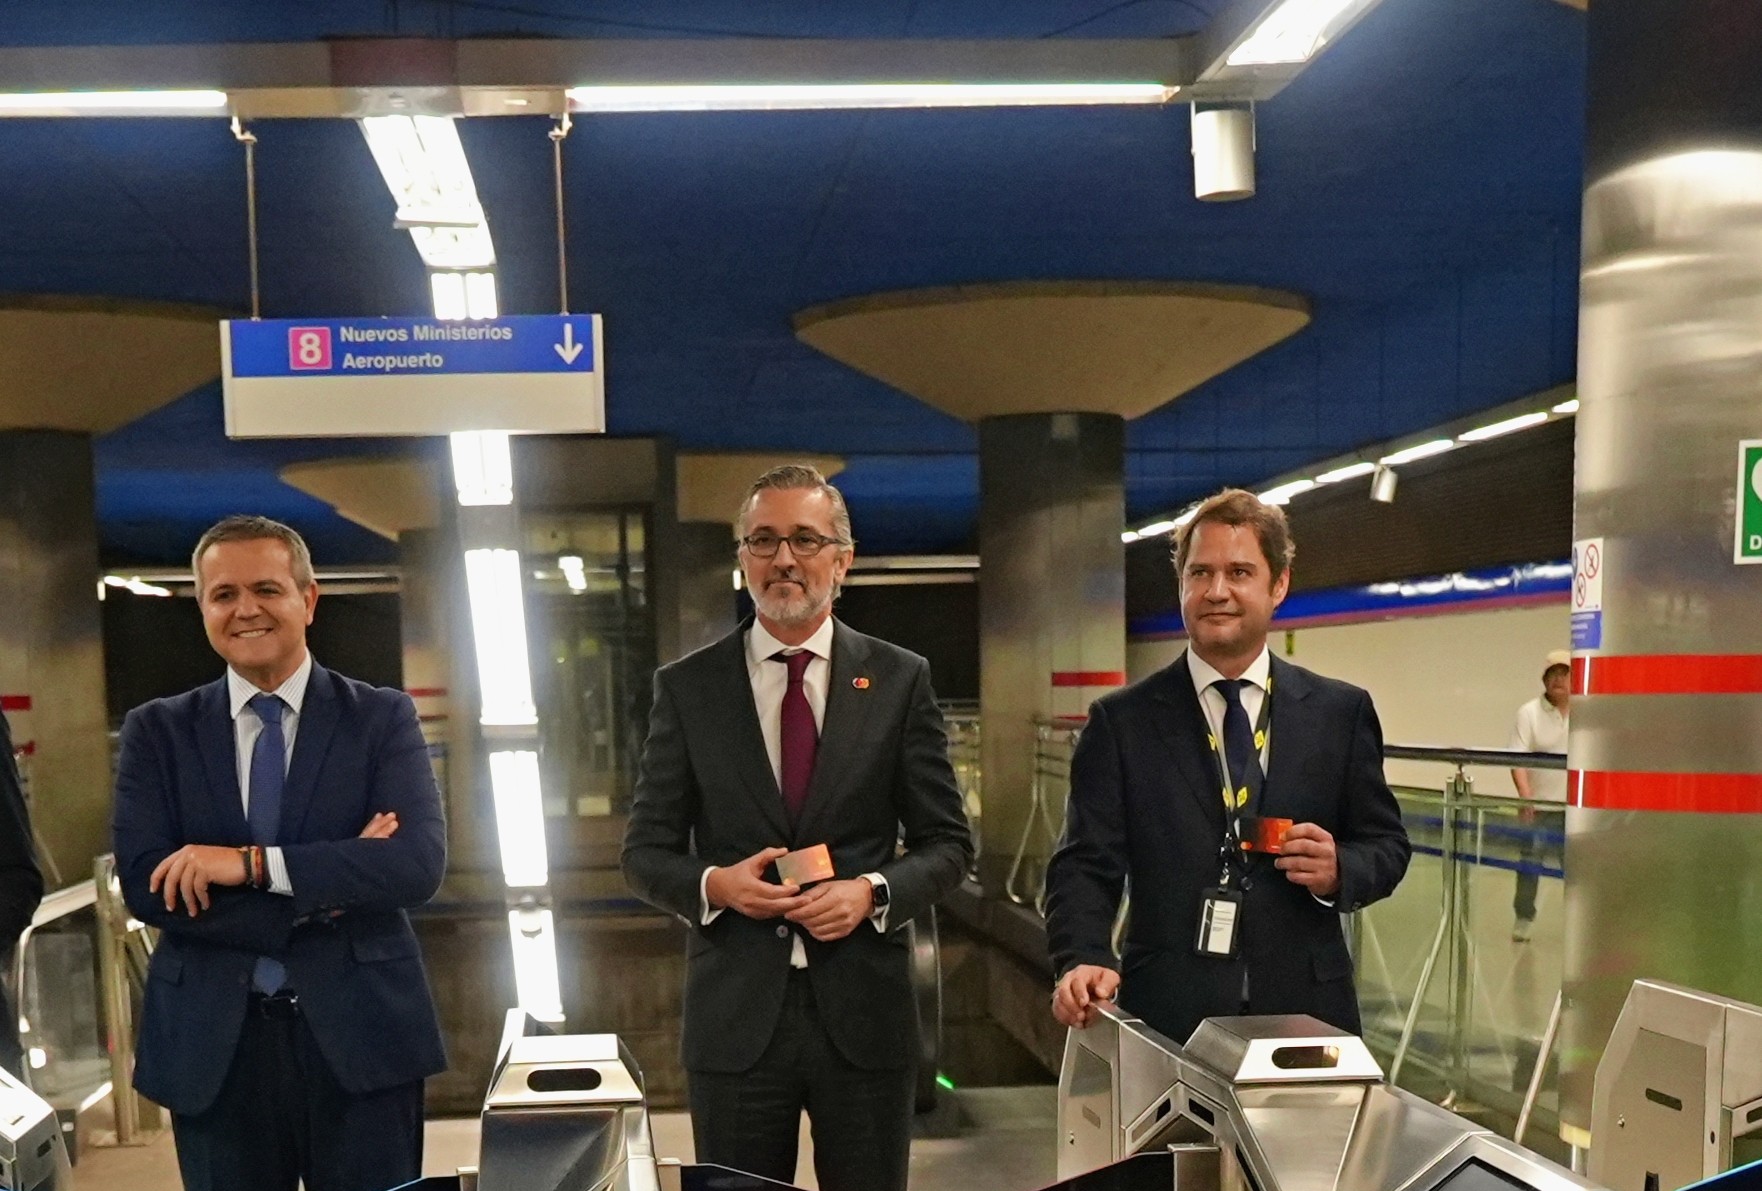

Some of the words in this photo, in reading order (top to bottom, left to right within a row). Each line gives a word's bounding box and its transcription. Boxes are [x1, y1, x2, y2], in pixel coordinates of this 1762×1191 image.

[340, 325, 408, 343] Nuevos
[413, 324, 513, 341] Ministerios
[299, 333, 323, 365] 8
[343, 353, 443, 371] Aeropuerto
